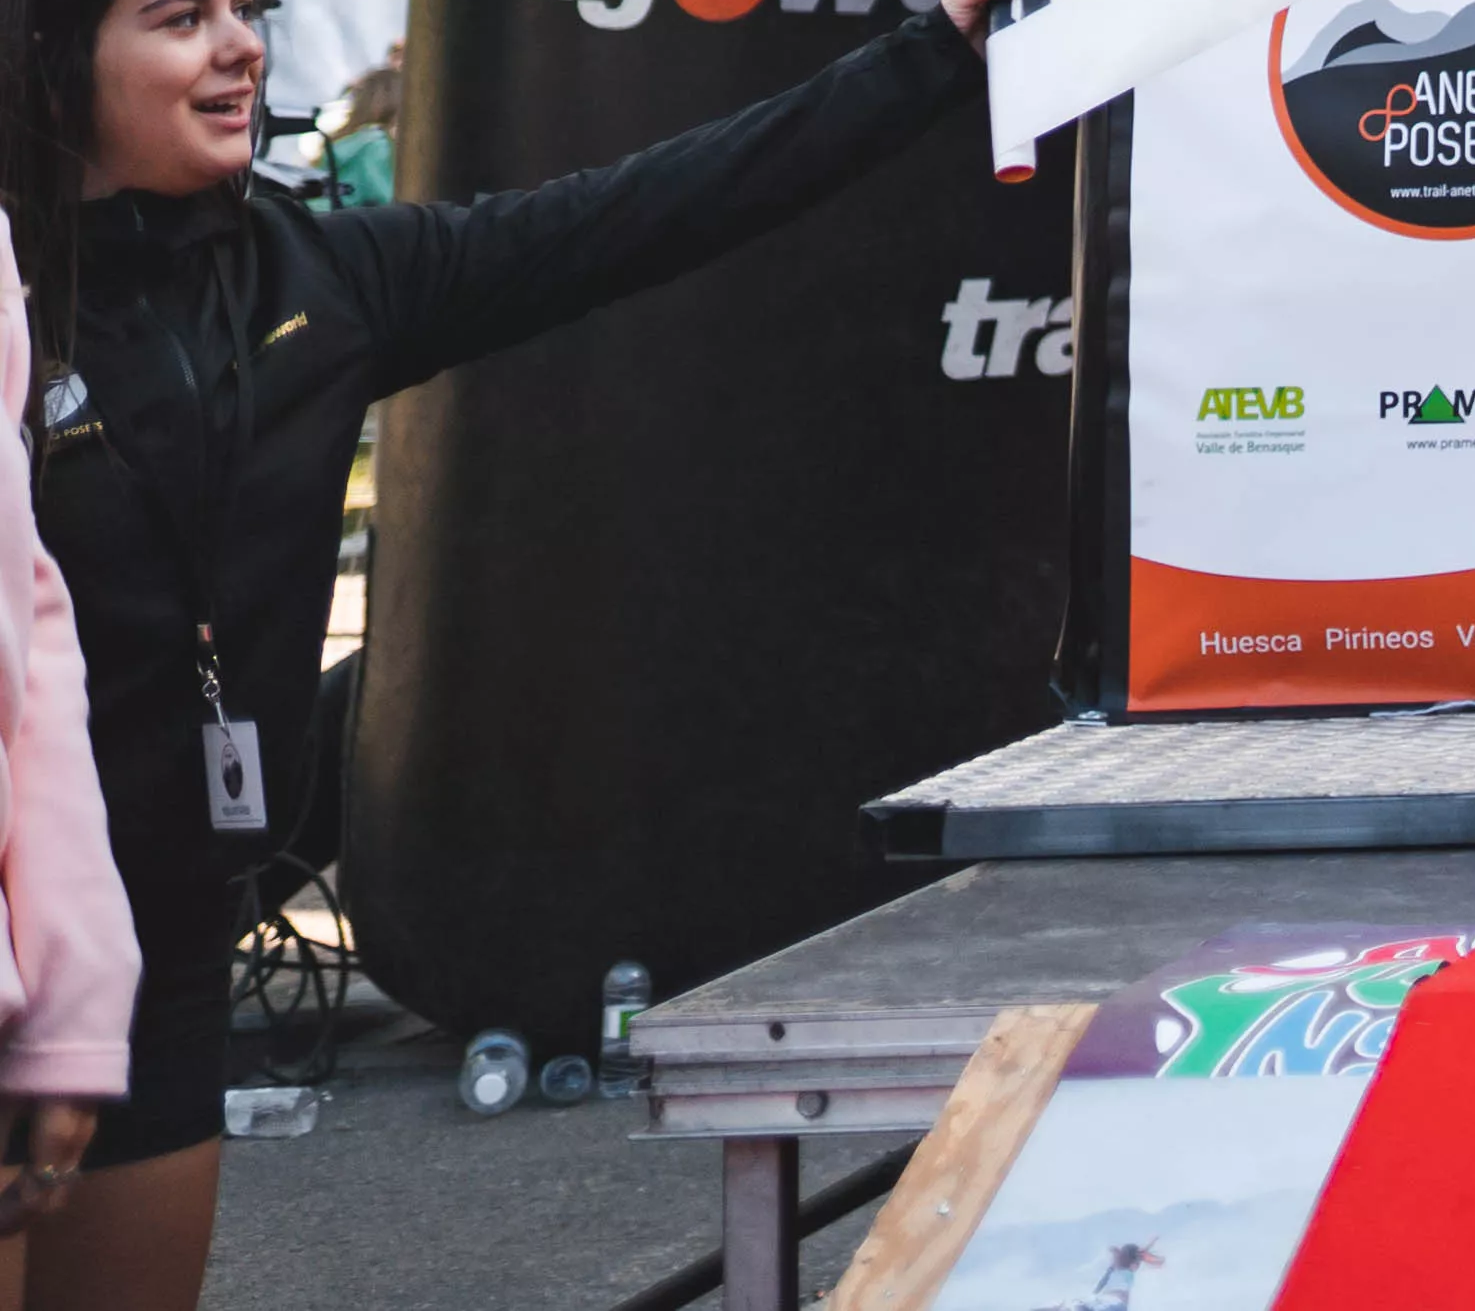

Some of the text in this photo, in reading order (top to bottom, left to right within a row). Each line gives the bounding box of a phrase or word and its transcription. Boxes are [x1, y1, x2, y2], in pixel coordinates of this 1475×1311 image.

[1196, 440, 1305, 455] Valle de Benasque
[1200, 629, 1303, 657] Huesca
[1325, 626, 1435, 652] Pirineos
